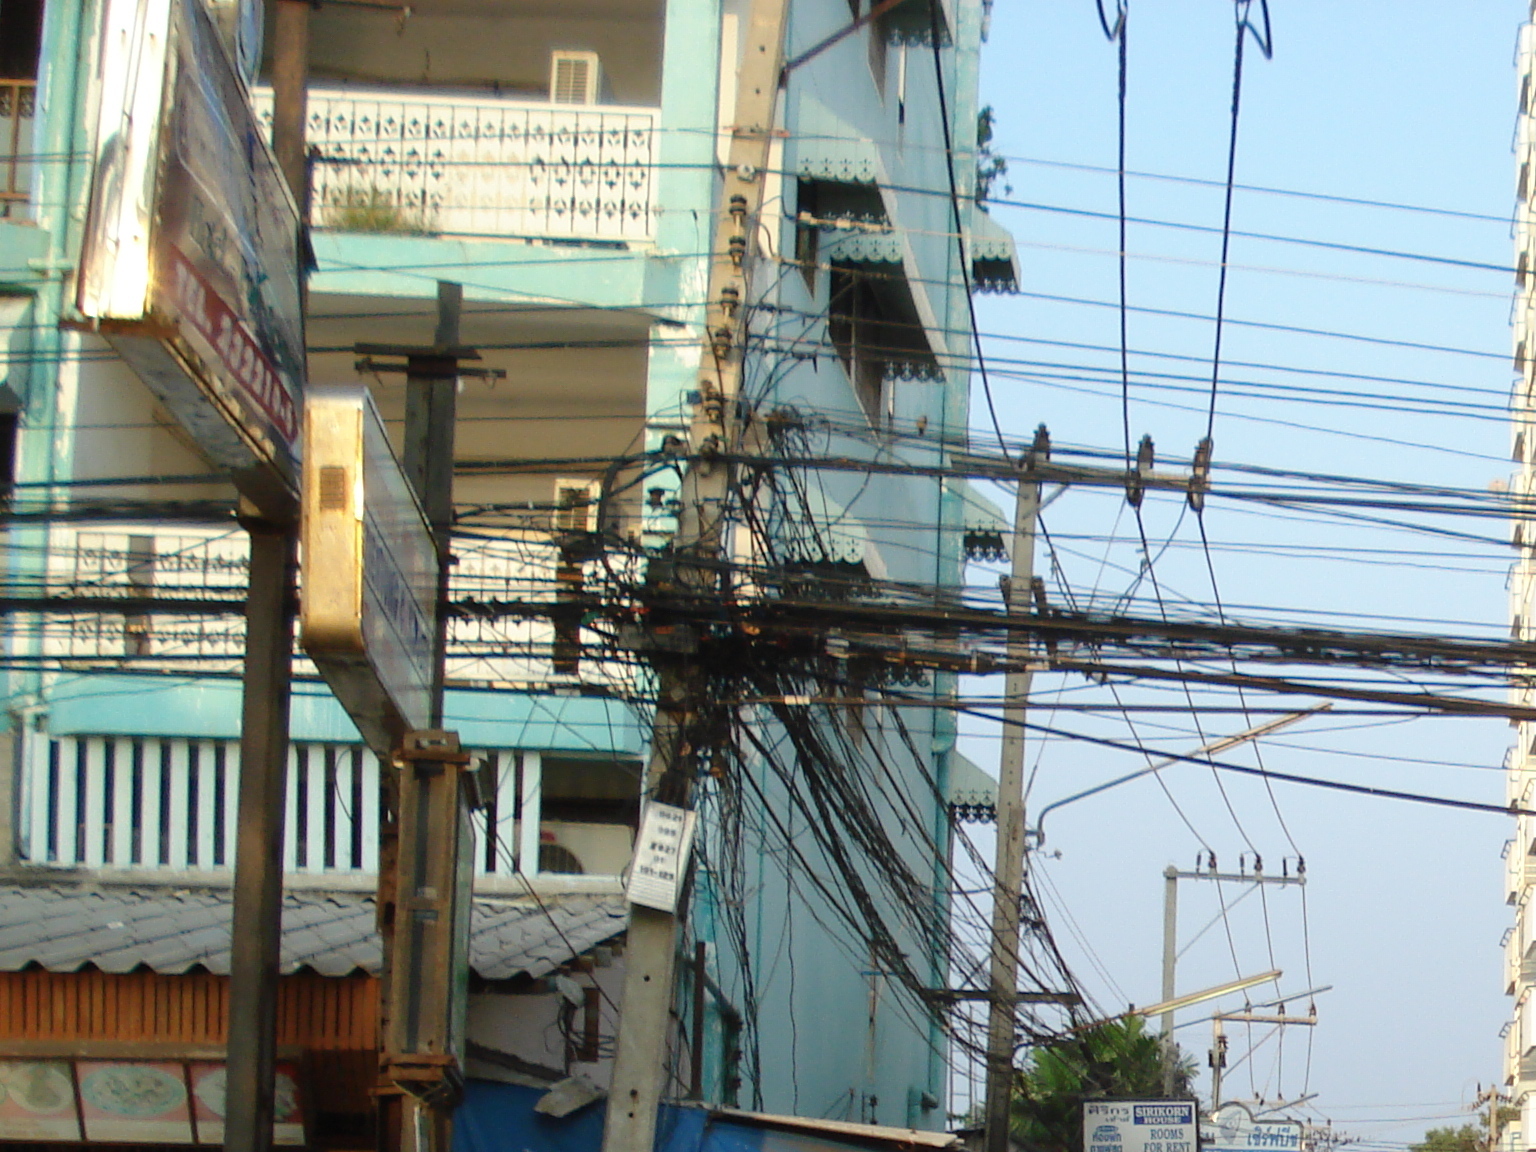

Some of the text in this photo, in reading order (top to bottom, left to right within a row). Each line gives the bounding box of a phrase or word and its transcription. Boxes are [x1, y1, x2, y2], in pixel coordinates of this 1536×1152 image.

[1135, 1106, 1189, 1117] SIRIKORN
[1143, 1116, 1182, 1124] HOUSE
[1150, 1129, 1184, 1140] ROOMS
[1144, 1142, 1191, 1152] FOR RENT
